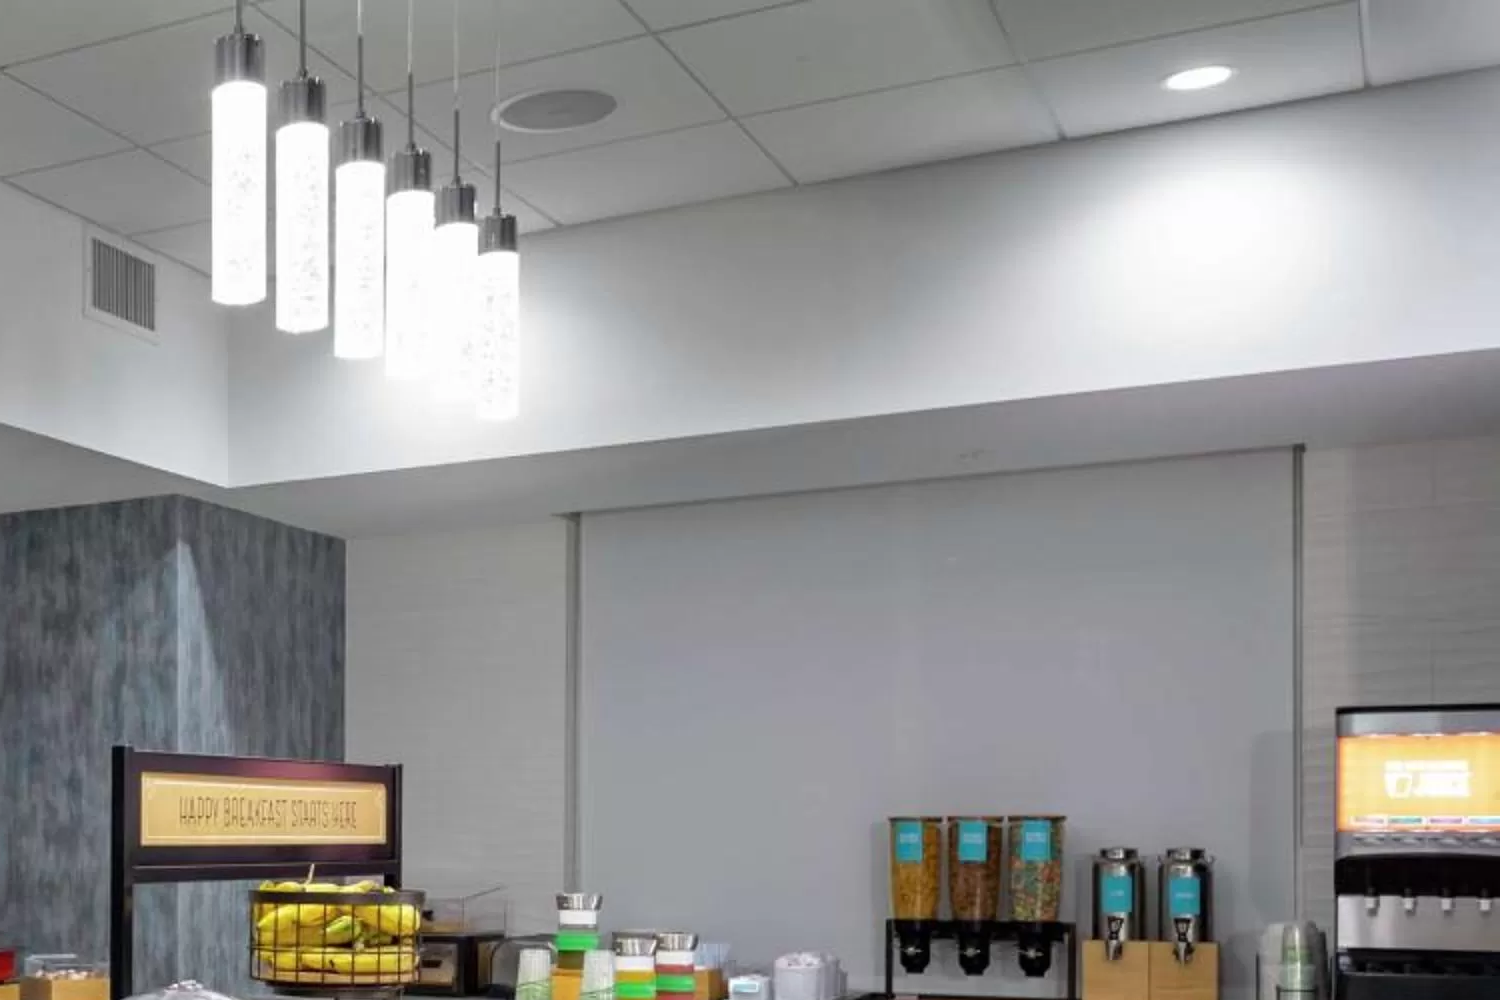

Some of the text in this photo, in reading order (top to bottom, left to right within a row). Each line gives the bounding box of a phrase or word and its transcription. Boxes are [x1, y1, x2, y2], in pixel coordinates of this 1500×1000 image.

[179, 796, 219, 827] HAPPY
[223, 796, 288, 829] BREAKFAST
[291, 799, 329, 829] STARTS
